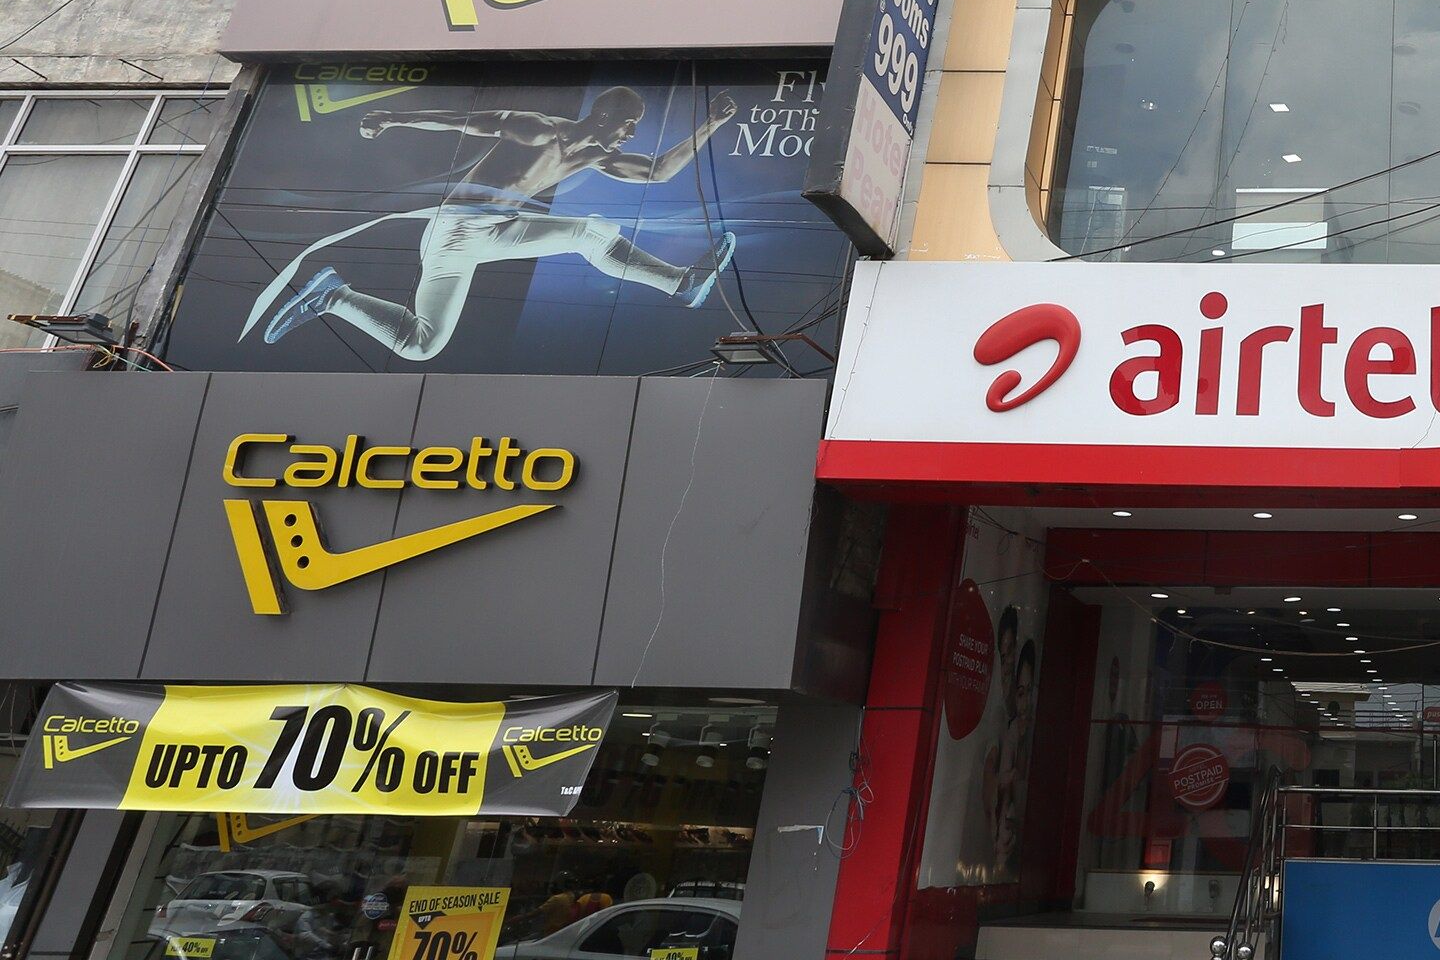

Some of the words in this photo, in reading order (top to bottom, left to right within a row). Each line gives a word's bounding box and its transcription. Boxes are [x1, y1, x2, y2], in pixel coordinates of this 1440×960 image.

[294, 62, 429, 83] Calcetto
[874, 13, 919, 114] 999
[223, 432, 581, 493] Calcetto
[1195, 700, 1224, 711] OPEN
[43, 715, 140, 734] Calcetto
[502, 724, 603, 743] Calcetto
[144, 743, 249, 790] UPTO
[252, 704, 413, 793] 70%
[412, 750, 481, 795] OFF
[1173, 763, 1224, 790] POSTPAID
[408, 899, 427, 914] END
[428, 898, 441, 912] OF
[441, 895, 477, 910] SEASON
[477, 891, 502, 907] SALE
